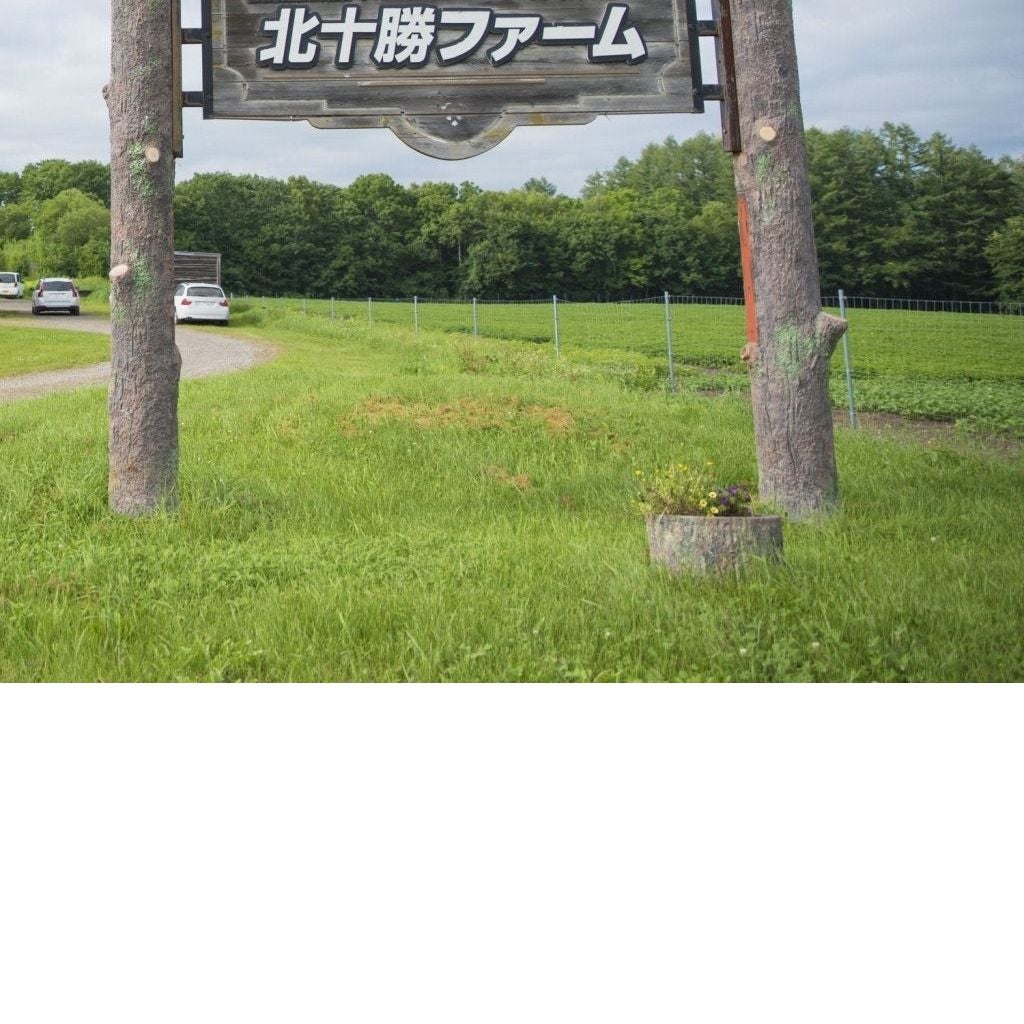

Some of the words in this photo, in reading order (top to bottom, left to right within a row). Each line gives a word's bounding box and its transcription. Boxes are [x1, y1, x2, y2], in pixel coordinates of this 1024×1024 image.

[259, 6, 646, 64] 北十勝ファーム
